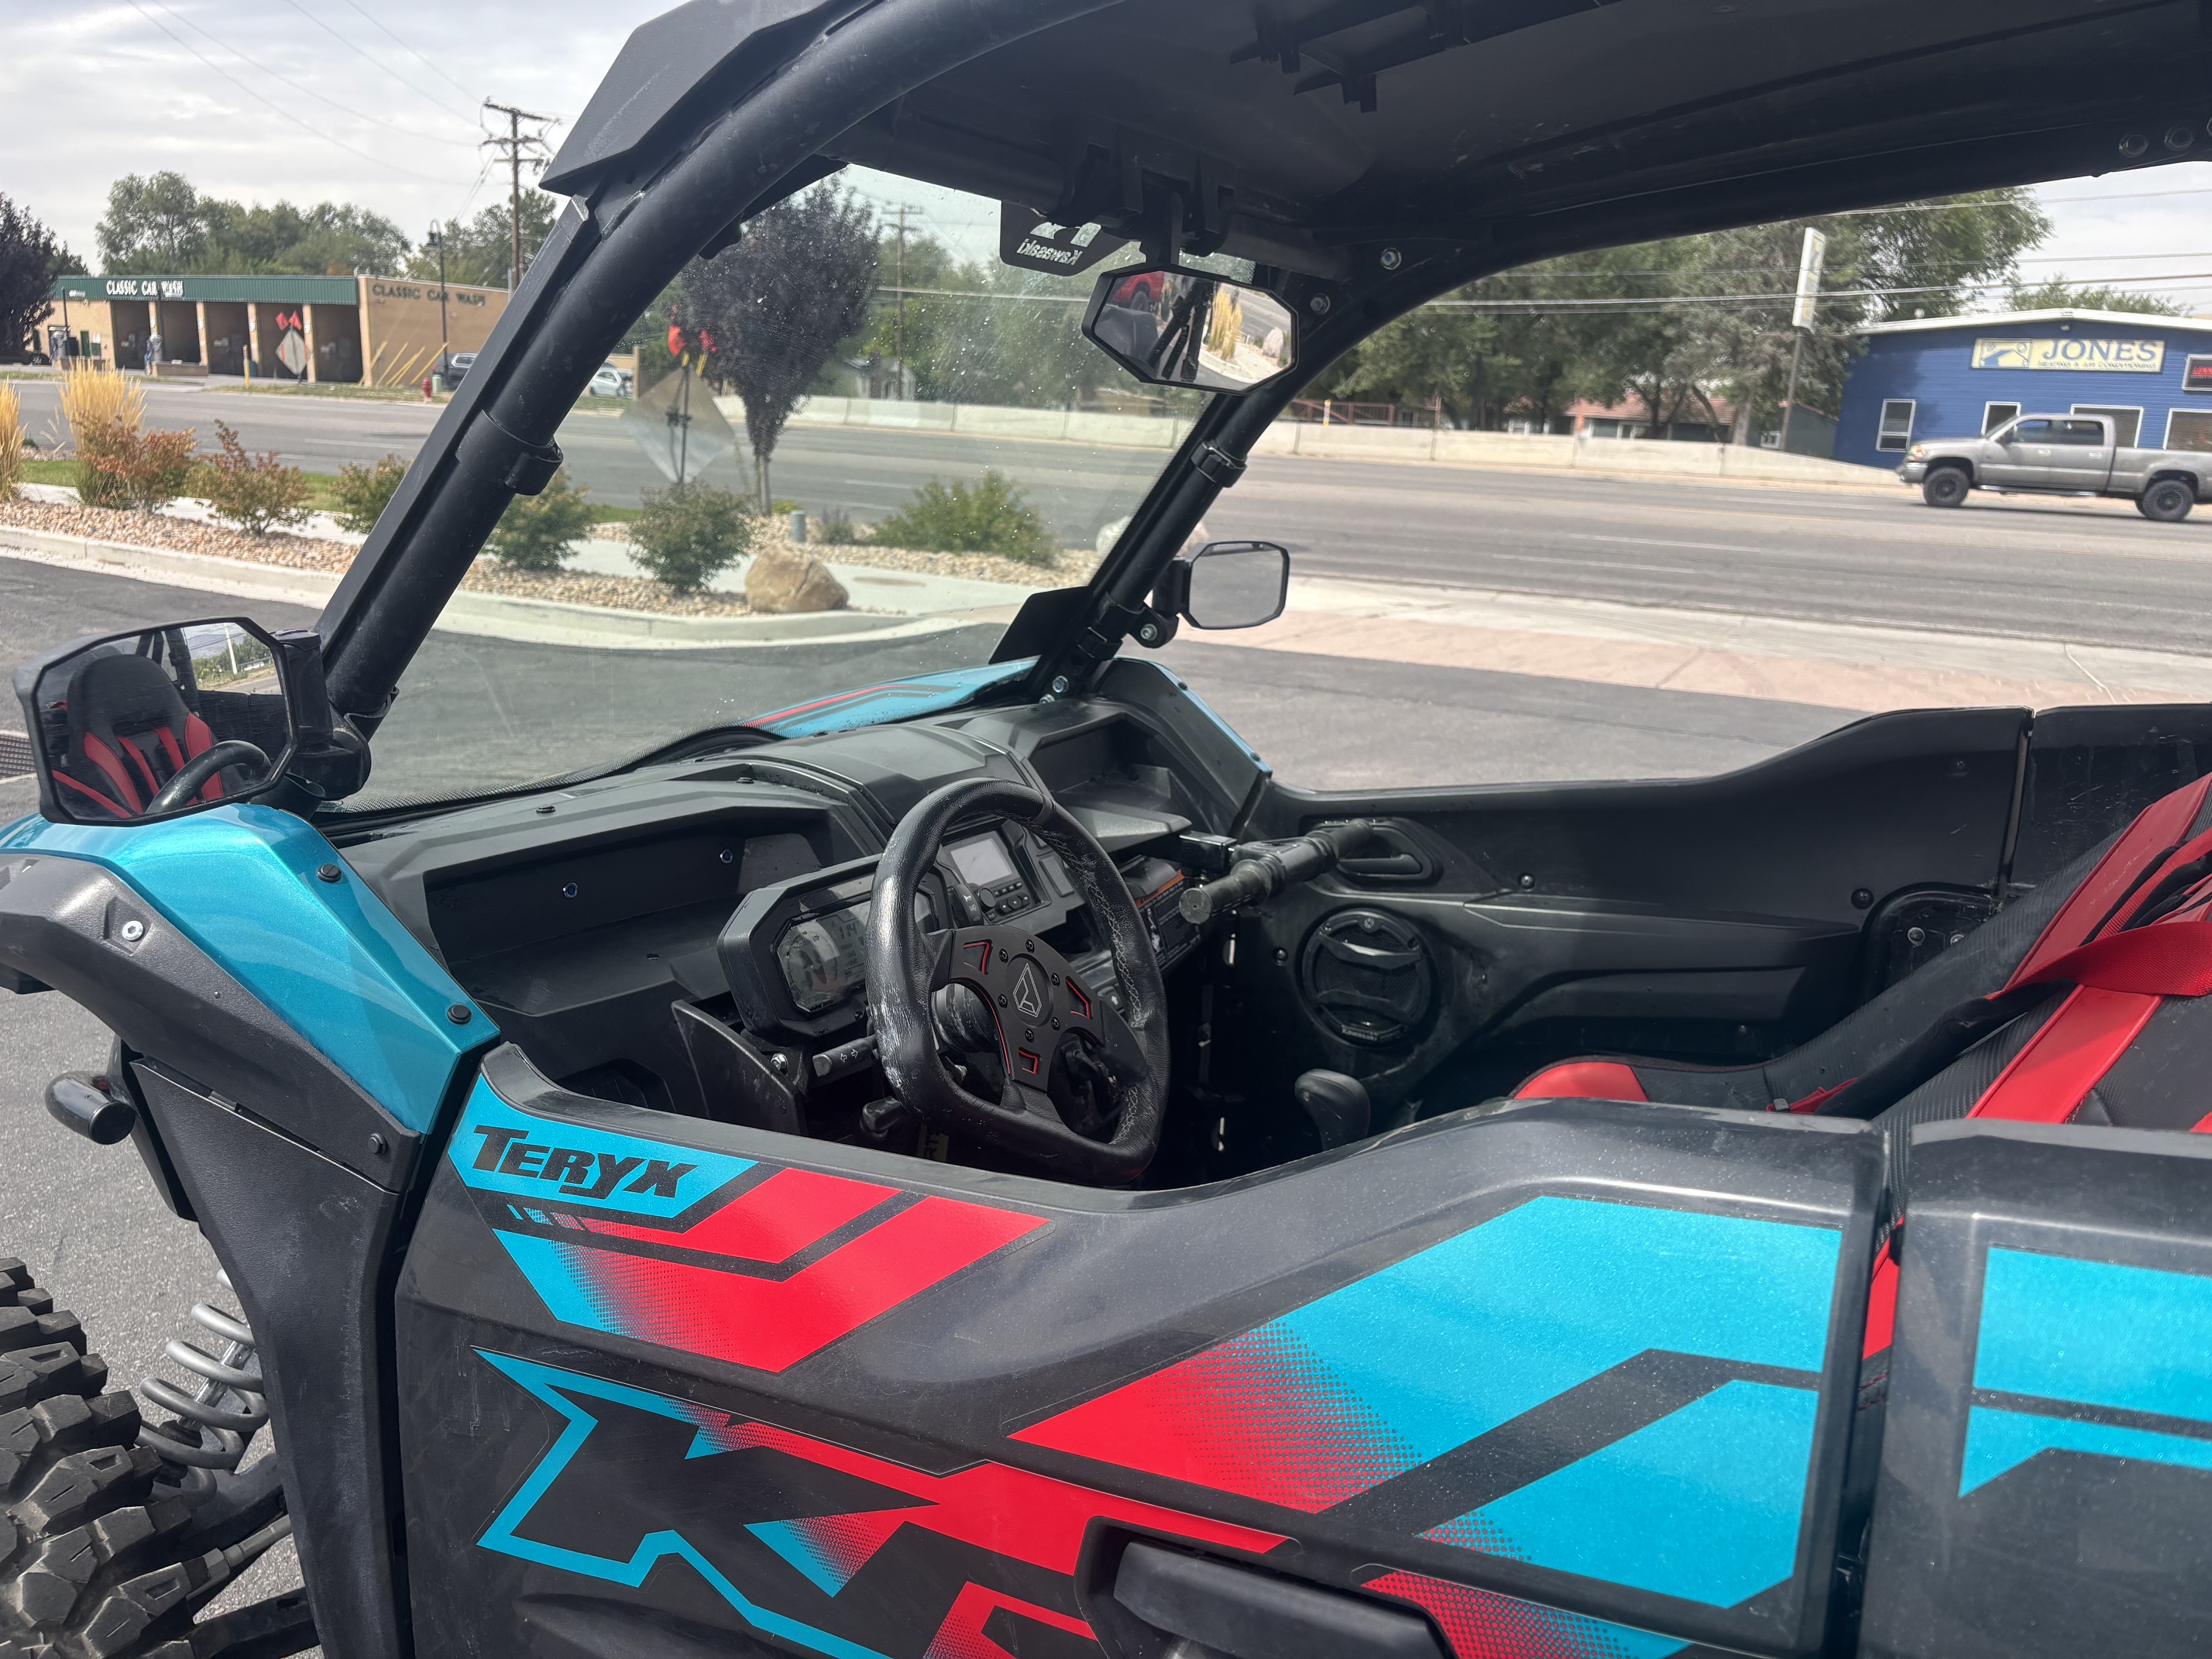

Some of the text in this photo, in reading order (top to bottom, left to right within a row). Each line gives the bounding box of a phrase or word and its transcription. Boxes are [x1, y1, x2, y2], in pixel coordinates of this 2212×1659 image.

[106, 280, 184, 296] CLASSIC CAR WASH
[372, 283, 486, 306] CLASSIC CAR WASH
[2042, 339, 2157, 362] JONES
[472, 1125, 699, 1200] TERYX
